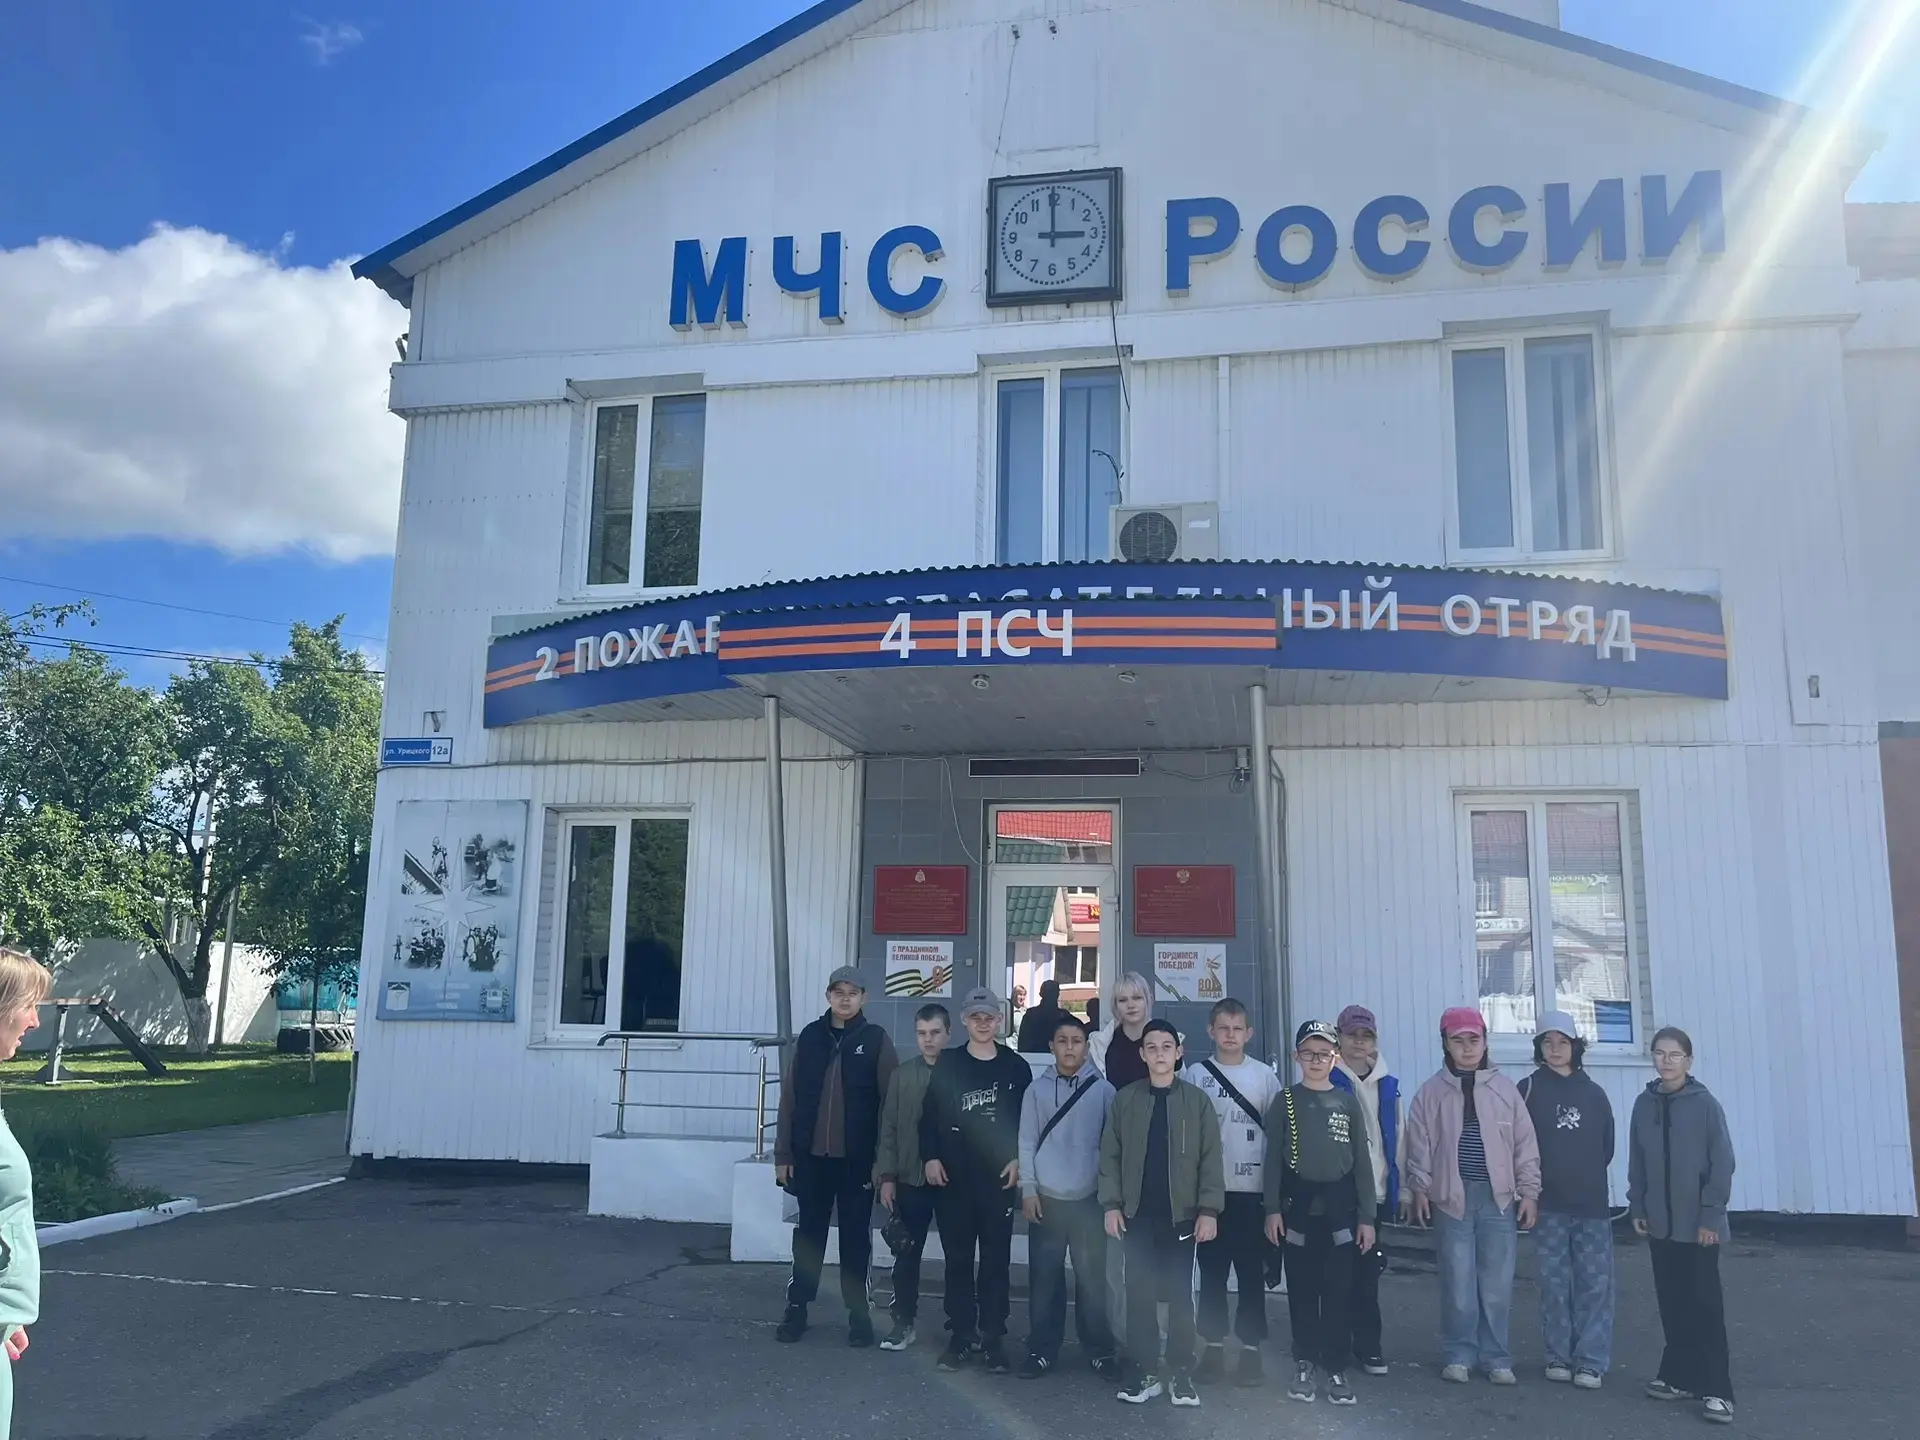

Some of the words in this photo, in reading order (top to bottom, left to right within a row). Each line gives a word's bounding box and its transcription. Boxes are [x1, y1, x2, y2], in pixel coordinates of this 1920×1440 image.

[1031, 199, 1039, 212] 11
[1070, 198, 1076, 211] 1
[1015, 212, 1028, 225] 10
[1082, 209, 1091, 222] 2
[1009, 232, 1017, 244] 9
[1089, 227, 1098, 239] 3
[669, 225, 946, 331] МЧС
[1166, 170, 1725, 297] РОССИИ
[1014, 249, 1023, 262] 8
[1081, 244, 1091, 257] 4
[1030, 259, 1039, 272] 7
[1048, 263, 1057, 276] 6
[1067, 257, 1076, 270] 5
[535, 646, 560, 682] 2
[1440, 593, 1636, 662] ОТРЯД
[879, 612, 916, 659] 4
[957, 608, 1073, 658] ПСЧ
[397, 748, 431, 756] Урицкого
[432, 746, 449, 755] 12а
[897, 945, 939, 953] ПРАЗДНИКОМ
[1158, 951, 1199, 960] ГОРДИМСЯ
[1158, 960, 1195, 970] ПОБЕДОЙ!
